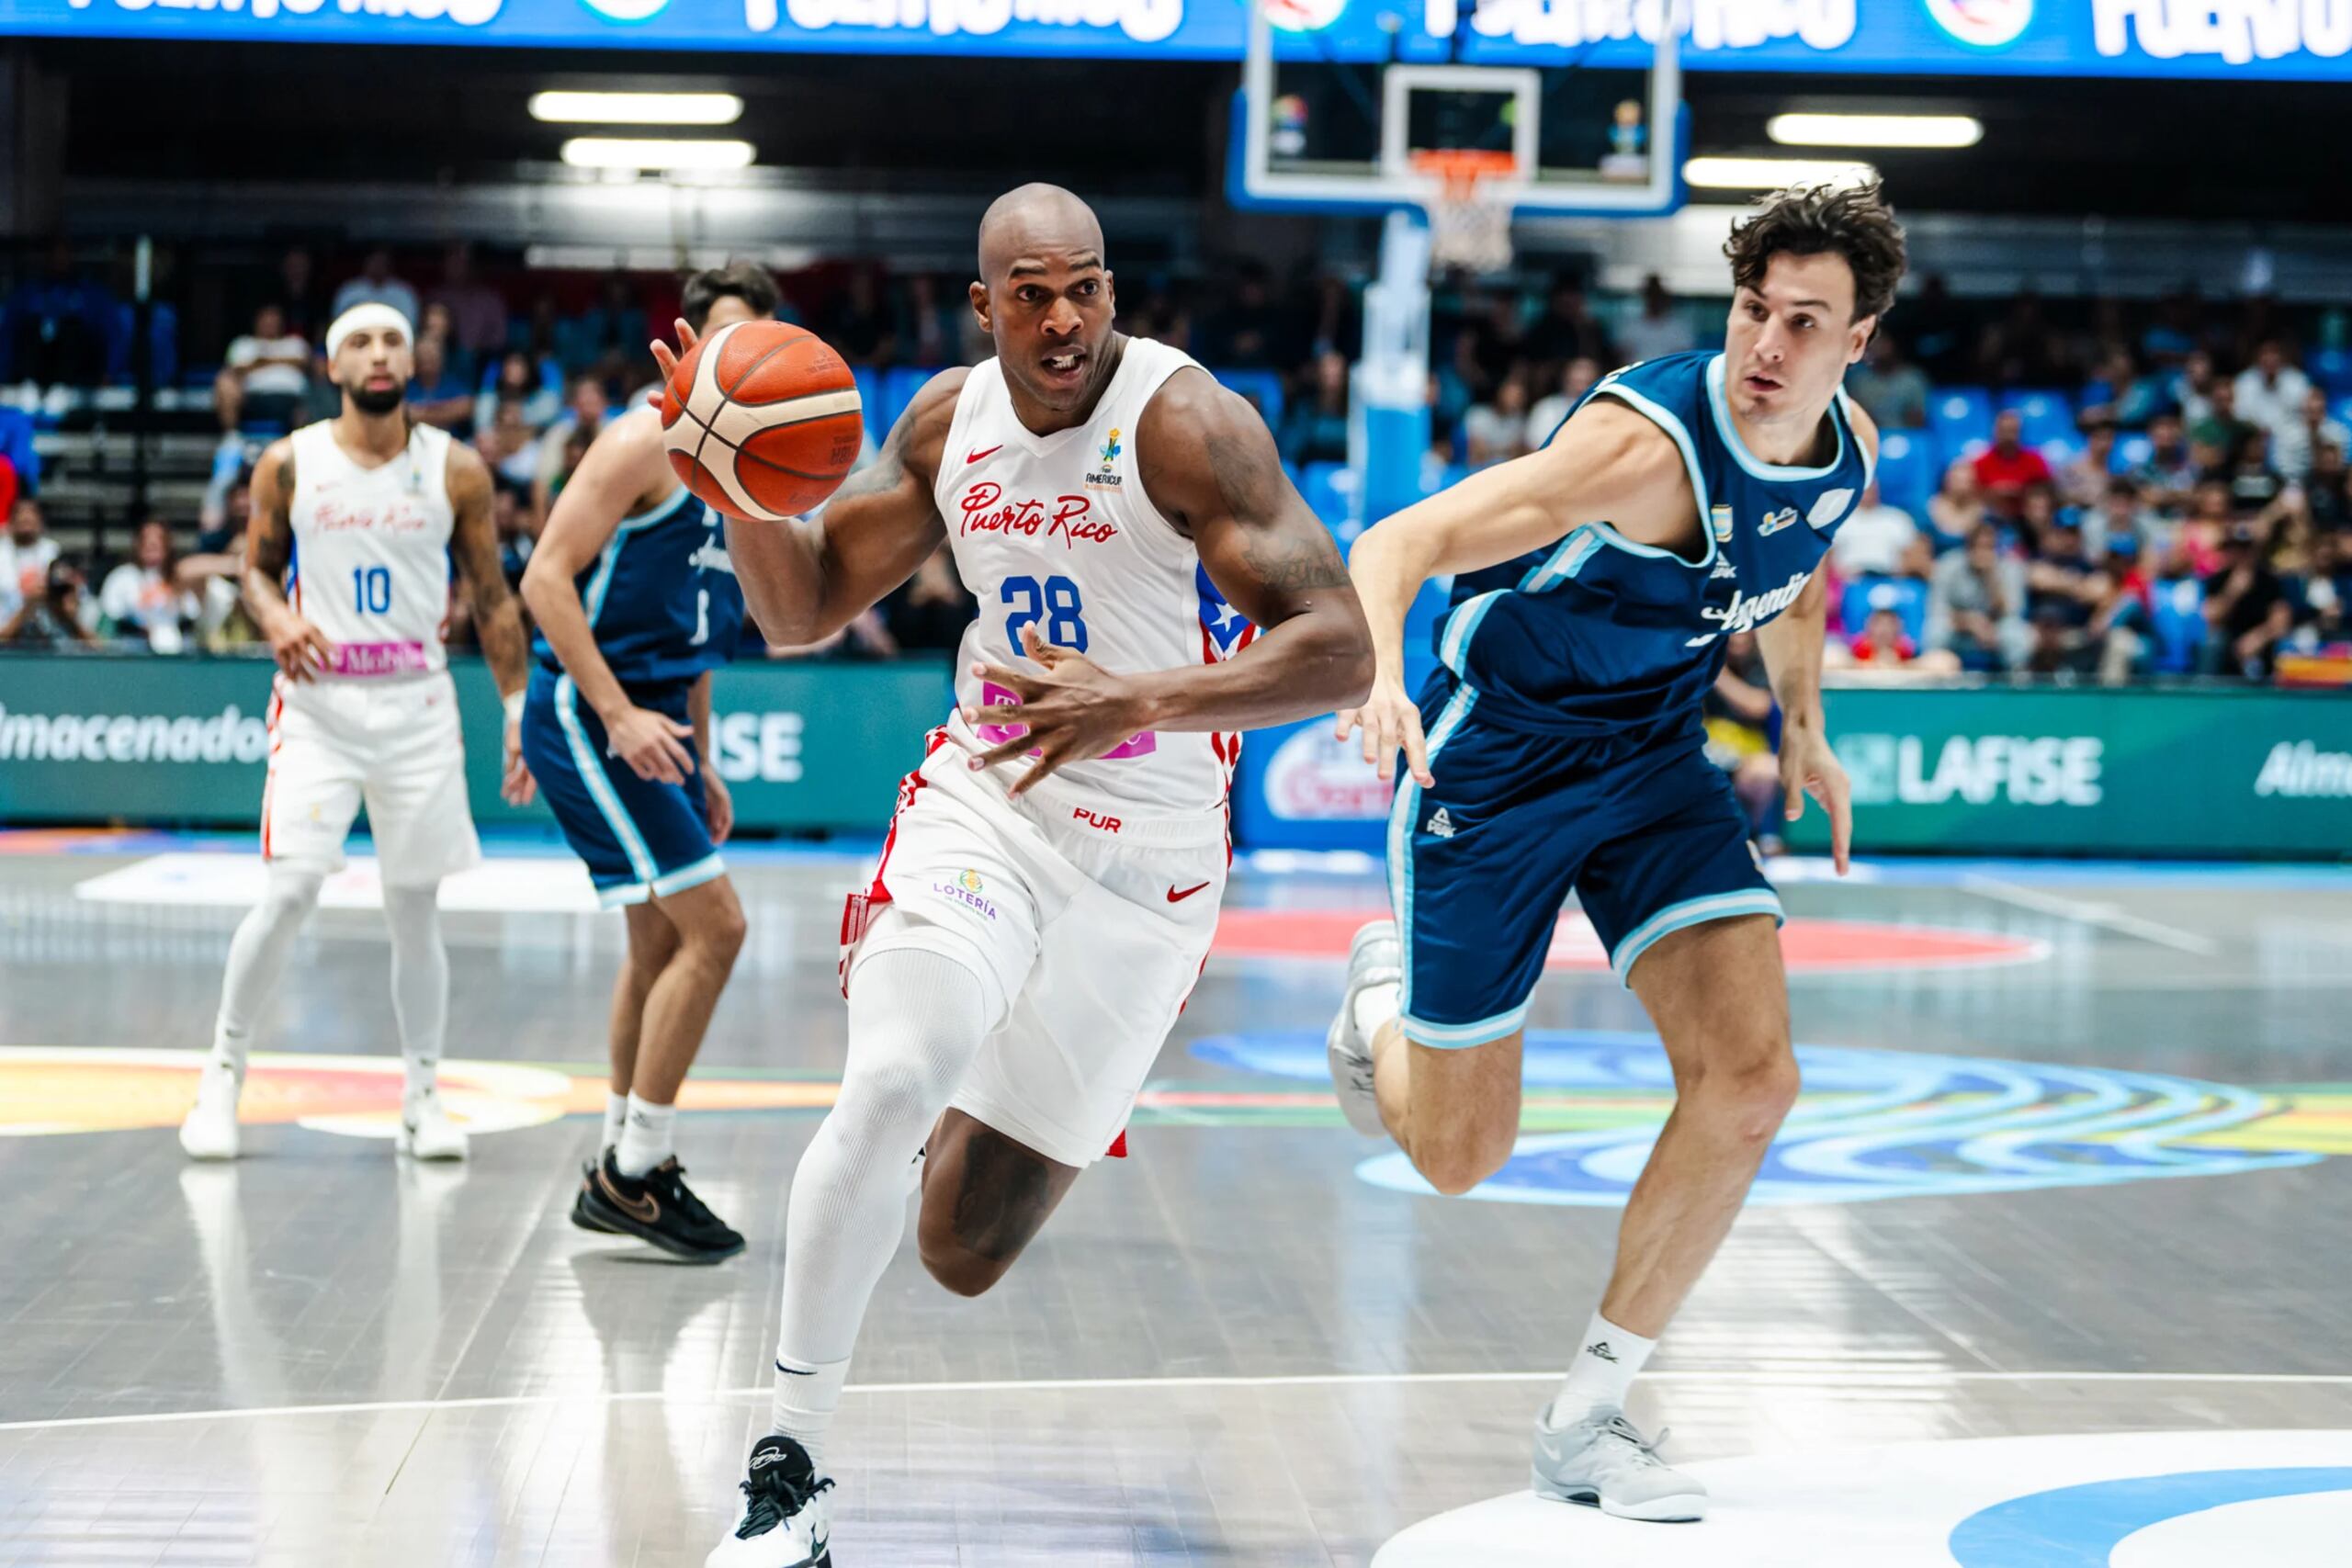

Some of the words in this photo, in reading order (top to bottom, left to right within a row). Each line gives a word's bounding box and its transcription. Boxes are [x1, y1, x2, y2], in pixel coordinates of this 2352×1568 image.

[960, 481, 1045, 537] Puerto
[1047, 494, 1118, 549] Rico
[354, 567, 391, 615] 10
[1000, 575, 1089, 658] 28
[0, 702, 268, 763] macenado
[1897, 735, 2104, 806] LAFISE
[1072, 807, 1123, 834] PUR
[933, 883, 996, 920] LOTERÍA
